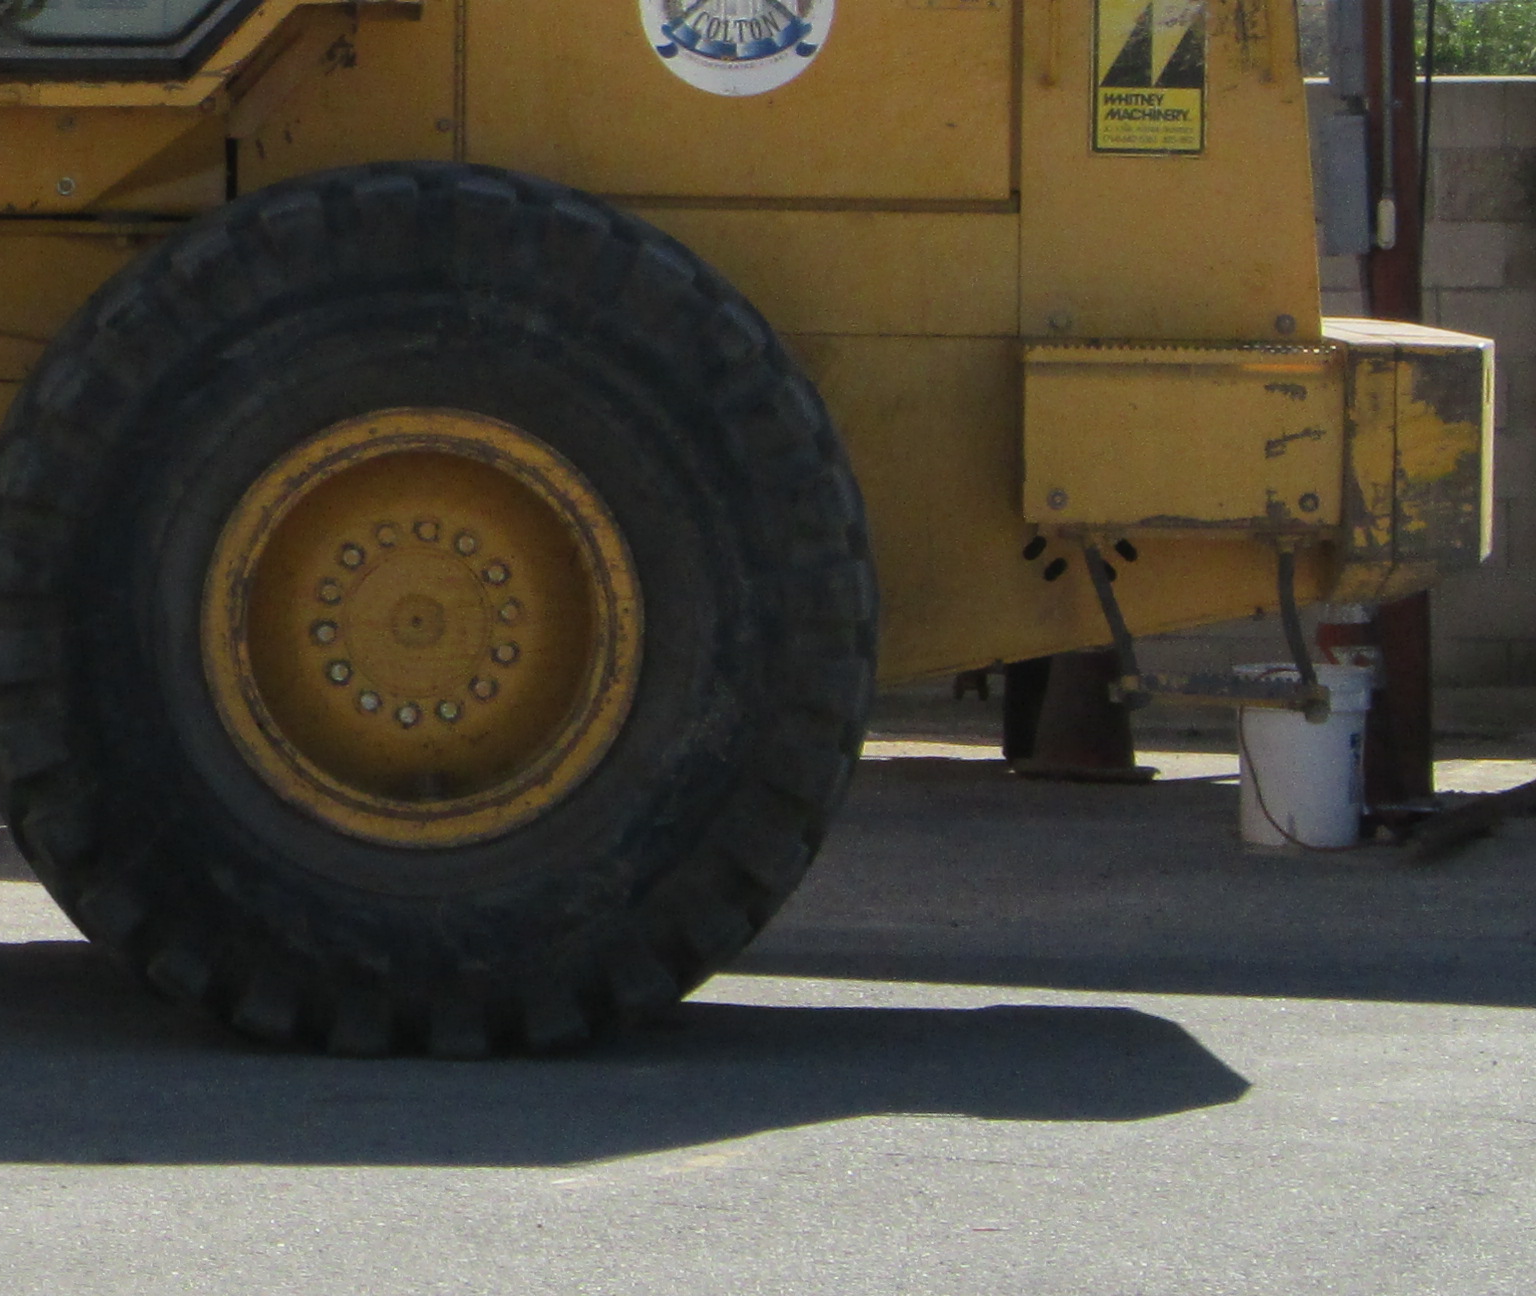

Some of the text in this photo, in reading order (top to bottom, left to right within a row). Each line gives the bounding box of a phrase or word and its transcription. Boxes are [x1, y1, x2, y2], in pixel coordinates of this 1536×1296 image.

[692, 11, 782, 44] COLTON
[1103, 92, 1165, 106] WHITNEY
[1104, 107, 1191, 121] MACHINERY
